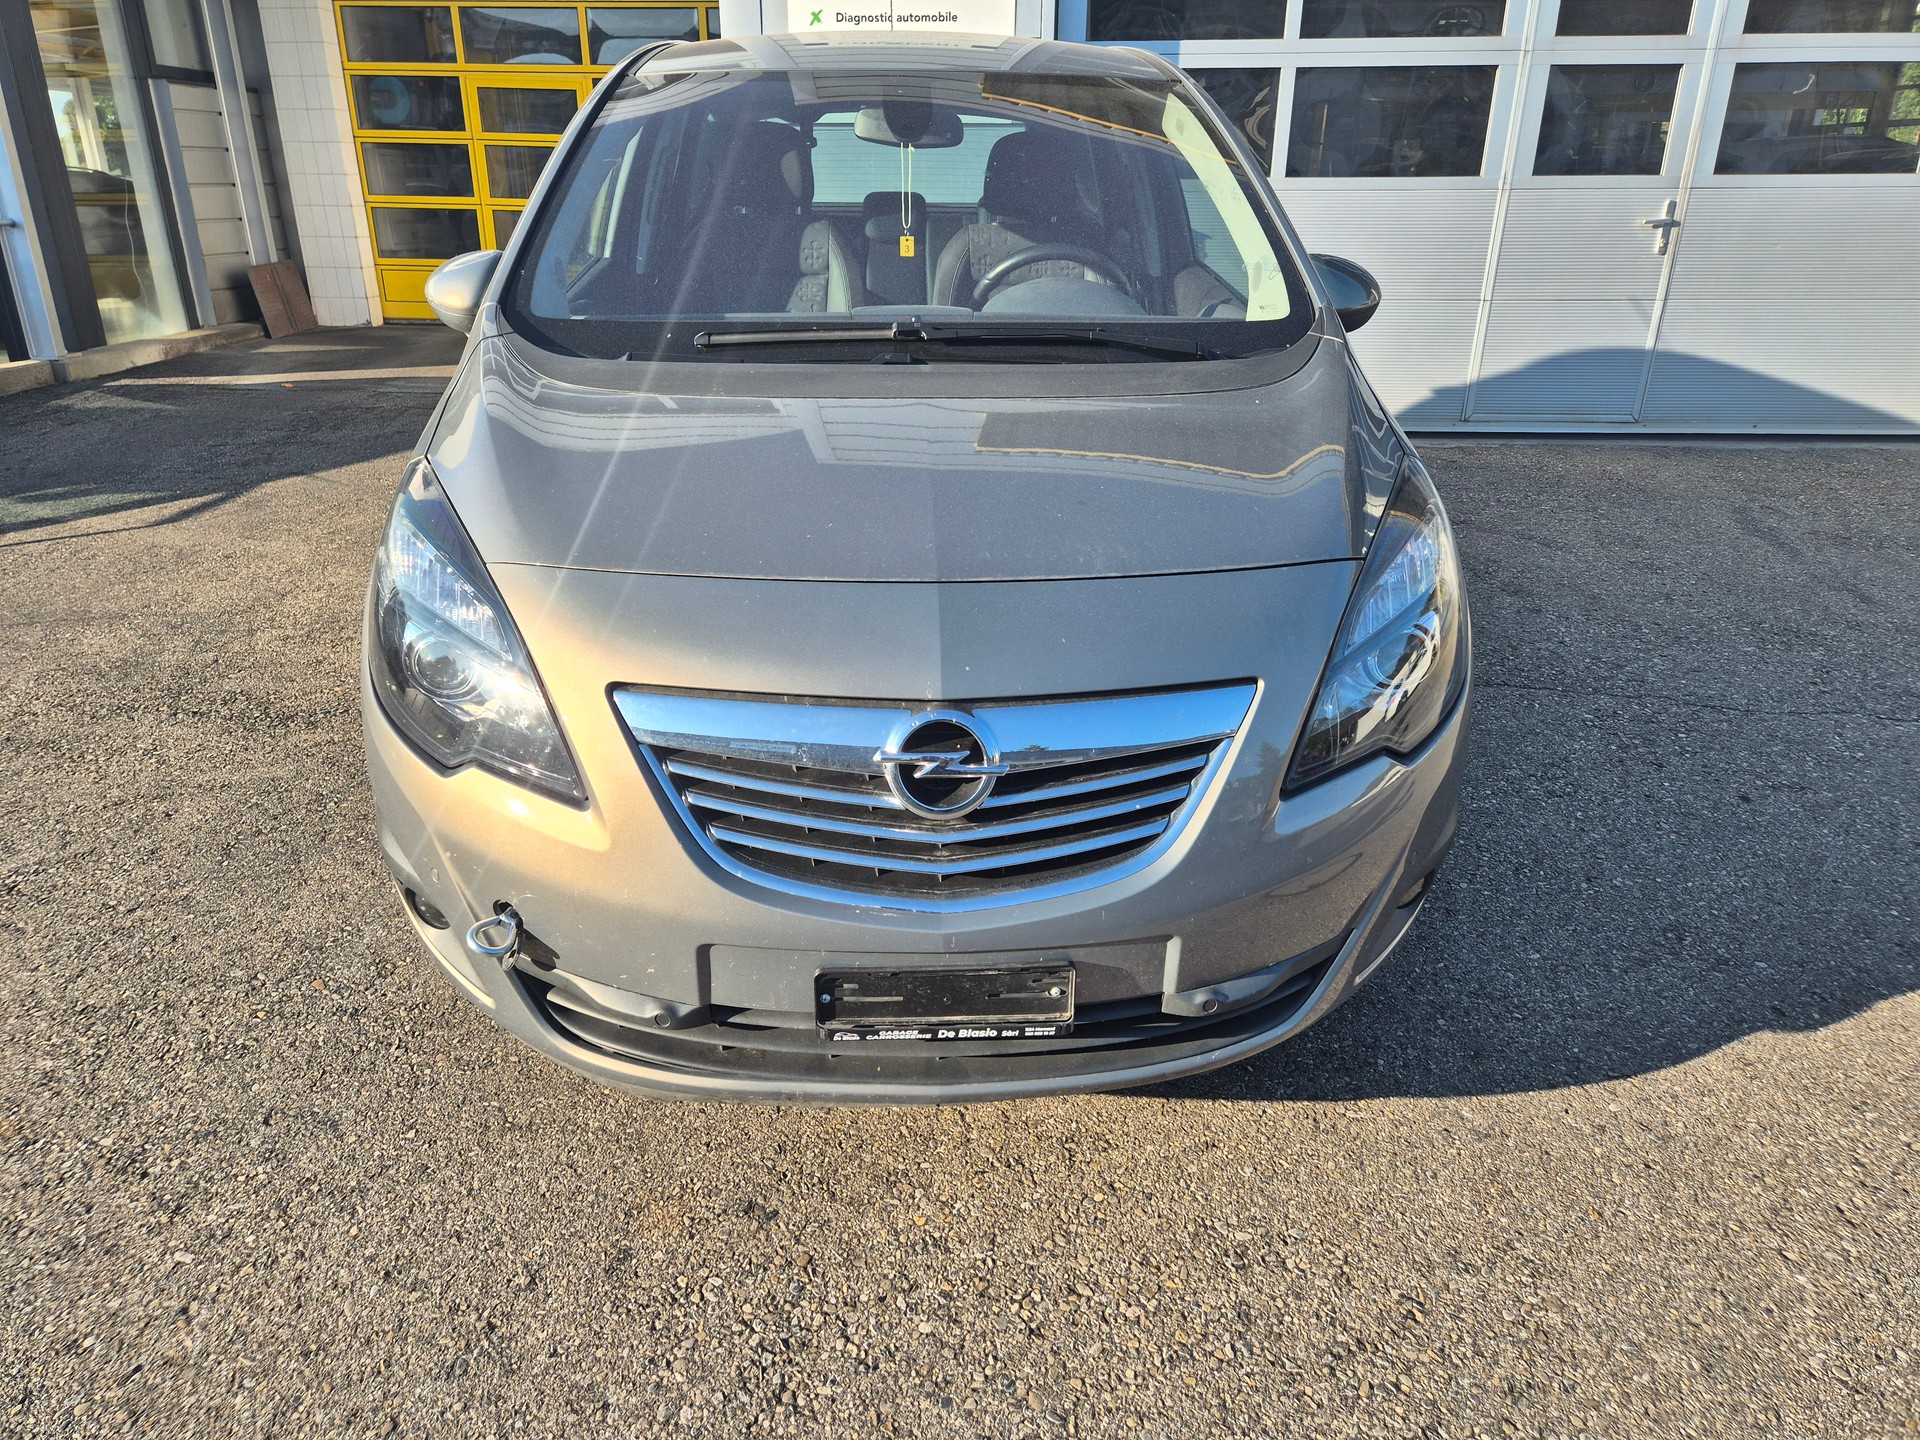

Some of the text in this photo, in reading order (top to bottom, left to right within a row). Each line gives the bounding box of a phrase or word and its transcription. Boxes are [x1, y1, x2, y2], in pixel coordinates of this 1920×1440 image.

[836, 11, 958, 25] Diagnostic automobile
[904, 244, 911, 254] 3
[937, 1029, 956, 1038] De
[958, 1027, 998, 1038] Blasio
